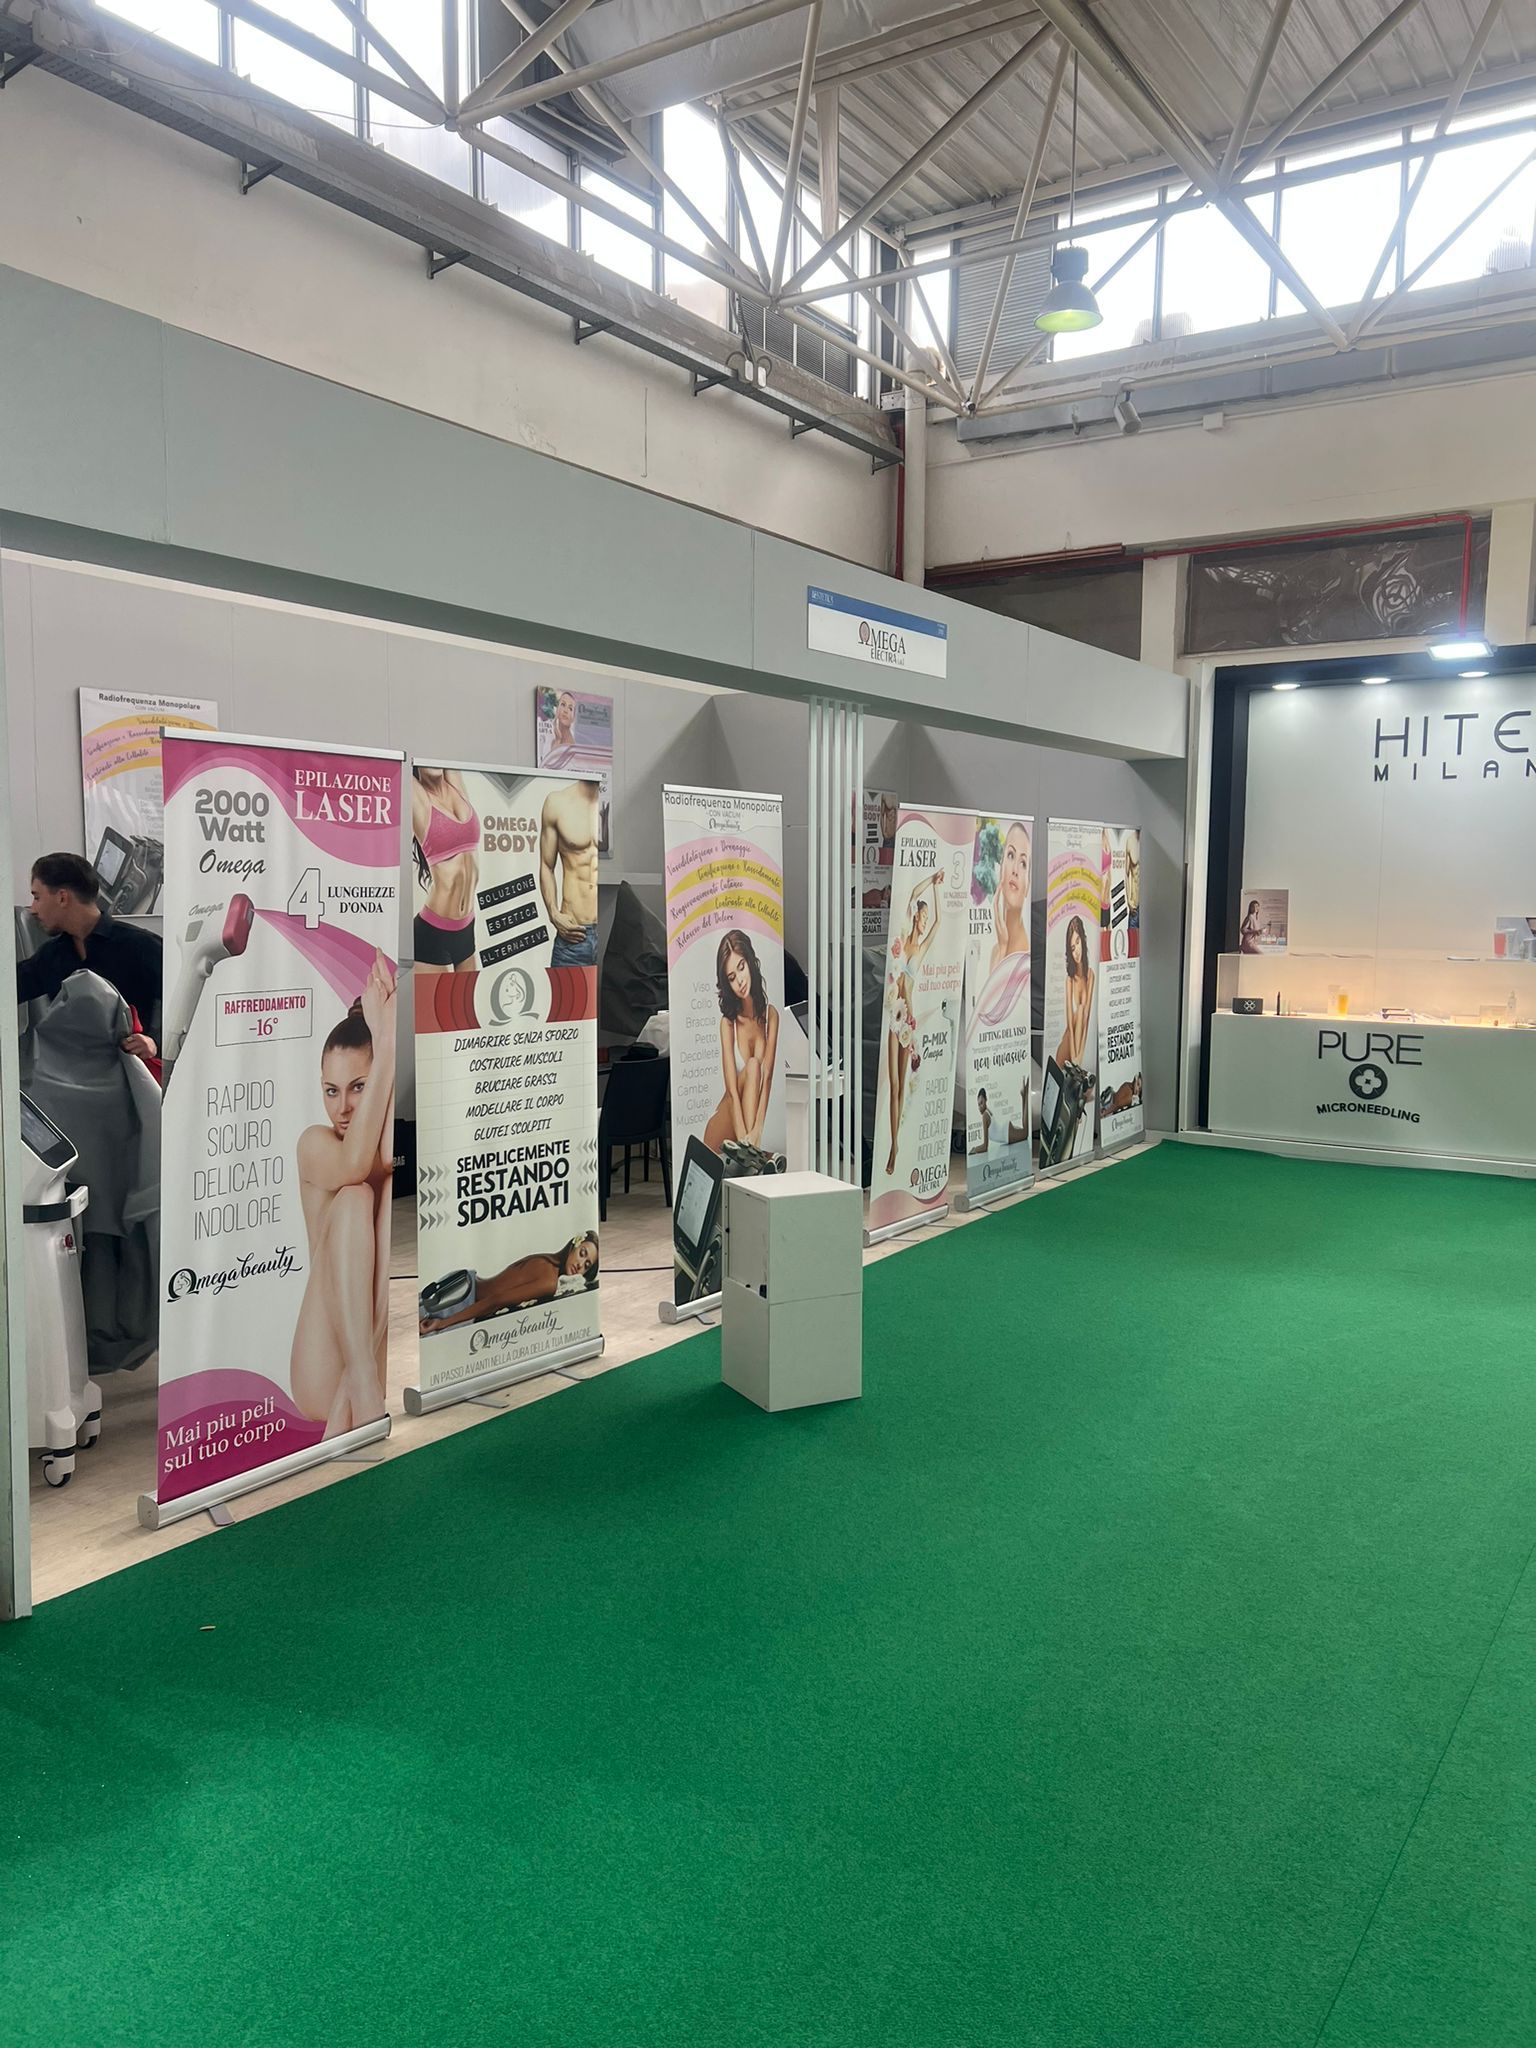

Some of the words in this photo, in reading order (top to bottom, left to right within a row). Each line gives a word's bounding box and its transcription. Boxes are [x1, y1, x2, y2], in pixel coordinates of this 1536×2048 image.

[871, 648, 896, 664] ELECTRA
[98, 693, 156, 706] Radiofrequenza
[158, 699, 200, 710] Monopolare
[294, 768, 392, 793] EPILAZIONE
[195, 788, 270, 818] 2000
[294, 790, 392, 825] LASER
[664, 793, 732, 808] Radiofrequenza
[734, 799, 780, 814] Monopolare
[199, 816, 266, 843] Watt
[484, 815, 538, 832] OMEGA
[484, 833, 538, 852] BODY
[901, 837, 936, 848] EPILAZIONE
[199, 849, 266, 882] Omega
[900, 849, 936, 868] LASER
[287, 868, 324, 930] 4
[328, 886, 396, 900] LUNGHEZZE
[479, 877, 536, 906] SOLUZIONE
[188, 902, 224, 917] Omega
[488, 906, 537, 932] ESTETICA
[702, 914, 712, 929] del
[714, 910, 734, 925] Dolore
[969, 908, 992, 920] ULTRA
[969, 922, 992, 935] LIFT-S
[482, 929, 548, 964] ALTERNATIVA
[922, 964, 935, 976] Mai
[948, 962, 960, 978] peli
[692, 982, 710, 992] Viso
[918, 980, 930, 992] sul
[930, 980, 942, 991] tuo
[224, 996, 306, 1015] RAFFREDDAMENTO
[690, 998, 712, 1010] Collo
[686, 1014, 716, 1029] Braccia
[454, 1034, 511, 1052] DIMAGRIRE
[514, 1031, 542, 1048] SENZA
[545, 1028, 578, 1042] SFORZO
[695, 1033, 718, 1044] Petto
[922, 1031, 948, 1048] P-MIX
[979, 1030, 1001, 1042] LIFTING
[1108, 1032, 1134, 1048] RESTANDO
[922, 1046, 943, 1062] Omega
[1108, 1044, 1134, 1064] SDRAIATI
[1318, 1030, 1424, 1066] PURE
[470, 1054, 522, 1072] COSTRUIRE
[523, 1051, 562, 1066] MUSCOLI
[682, 1065, 718, 1079] Addome
[474, 1076, 522, 1094] BRUCIARE
[524, 1072, 557, 1087] GRASSI
[926, 1076, 948, 1096] RAPIDO
[207, 1080, 274, 1117] RAPIDO
[466, 1098, 522, 1118] MODELLARE
[524, 1098, 534, 1110] IL
[536, 1094, 564, 1108] CORPO
[686, 1100, 713, 1111] Glutei
[924, 1098, 946, 1118] SICURO
[676, 1112, 708, 1126] Muscoli
[1316, 1102, 1420, 1124] MICRONEEDLING
[207, 1118, 272, 1157] SICURO
[474, 1123, 508, 1141] GLUTEI
[510, 1118, 552, 1136] SCOLPITI
[919, 1118, 948, 1141] DELICATO
[456, 1140, 570, 1174] SEMPLICEMENTE
[918, 1138, 946, 1162] INDOLORE
[194, 1156, 284, 1201] DELICATO
[457, 1158, 570, 1199] RESTANDO
[918, 1178, 940, 1194] ELECTRA
[457, 1180, 569, 1228] SDRAIATI
[194, 1193, 282, 1240] INDOLORE
[430, 1373, 440, 1386] UN
[440, 1366, 464, 1382] PASSO
[464, 1360, 490, 1376] AVANTI
[490, 1354, 512, 1371] NELLA
[512, 1346, 530, 1361] CURA
[530, 1342, 550, 1356] DELLA
[552, 1337, 564, 1348] TUA
[564, 1327, 591, 1346] IMMAGINE
[164, 1421, 200, 1450] Mai
[206, 1413, 236, 1440] piu
[241, 1396, 275, 1428] peli
[164, 1446, 193, 1473] sul
[198, 1438, 229, 1461] tuo
[233, 1418, 286, 1443] corpo
